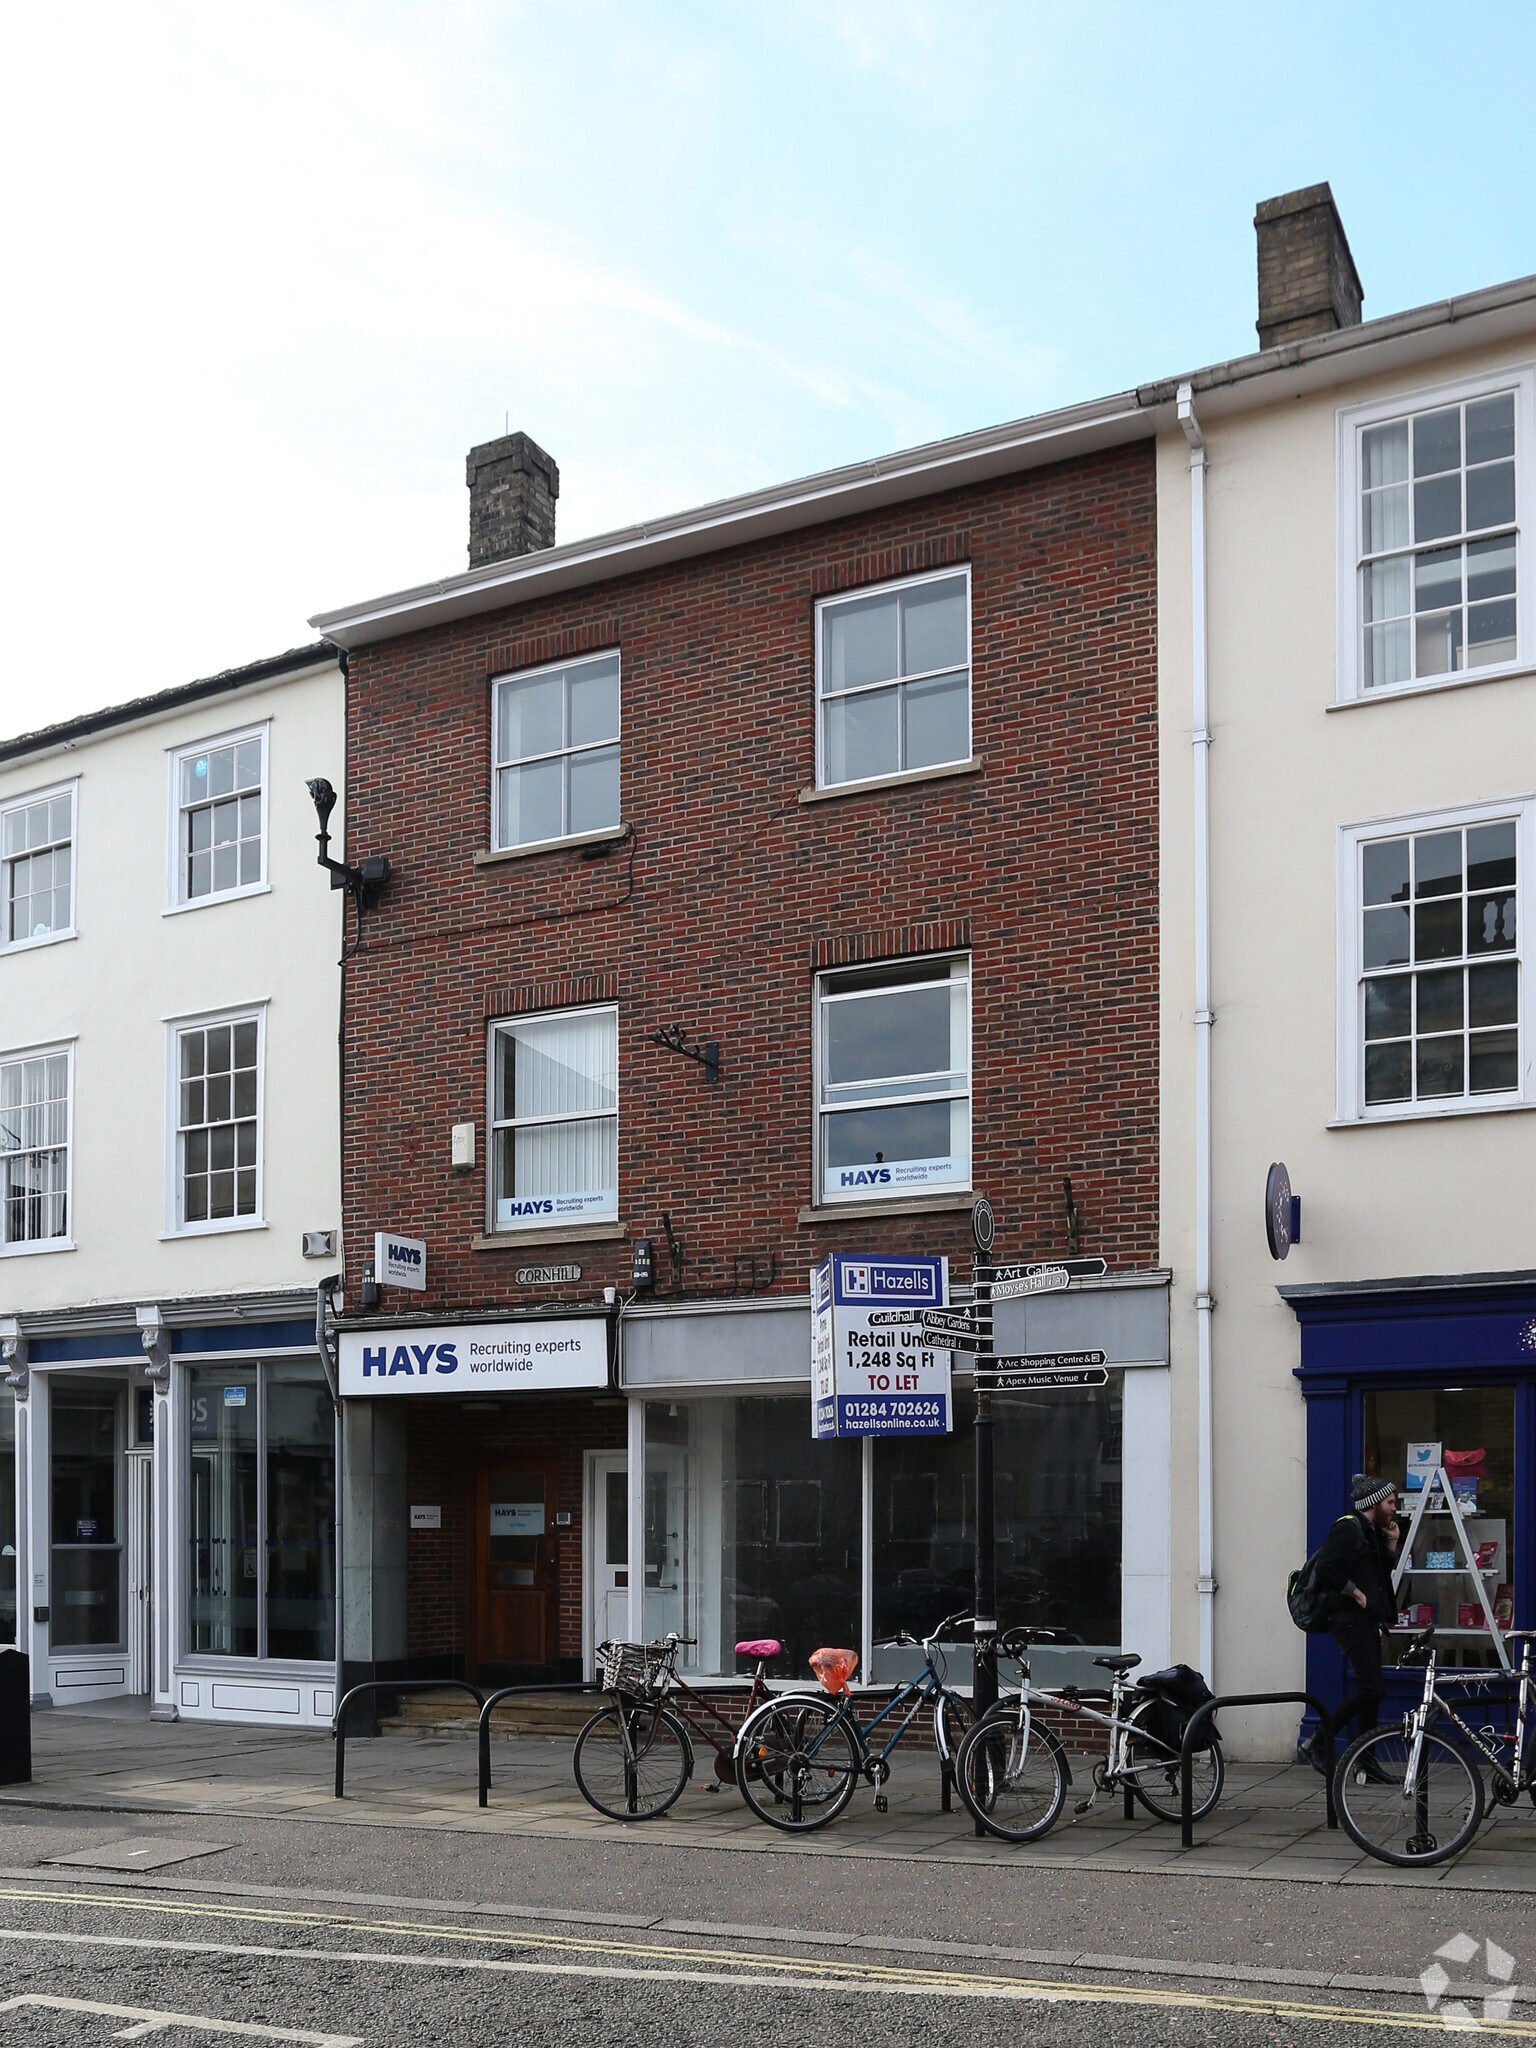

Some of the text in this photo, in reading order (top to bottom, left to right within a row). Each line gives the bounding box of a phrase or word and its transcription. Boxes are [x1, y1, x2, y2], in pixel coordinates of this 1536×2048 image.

[841, 1163, 952, 1186] HAYS Recruiting experts
[895, 1173, 928, 1181] worldwide
[511, 1195, 604, 1216] HAYS Recruiting experts
[556, 1204, 584, 1212] worldwide
[388, 1244, 421, 1265] HAYS
[388, 1261, 420, 1273] Recruiting experts
[388, 1269, 407, 1277] worldwide
[517, 1266, 578, 1283] CORNHILL
[1003, 1268, 1021, 1279] Art
[874, 1270, 929, 1290] Hazells
[995, 1281, 1029, 1296] Moyse's
[1030, 1275, 1046, 1290] Hall
[872, 1310, 914, 1323] Guildhall
[926, 1313, 970, 1331] Abbey Gardens
[848, 1331, 895, 1348] Retail
[926, 1332, 957, 1348] Cathedral
[362, 1338, 581, 1377] HAYS Recruiting experts
[847, 1351, 891, 1369] 1,248
[896, 1351, 916, 1371] Sq
[921, 1352, 935, 1368] Ft
[1005, 1360, 1019, 1368] Arc
[1020, 1356, 1056, 1367] Shopping
[1057, 1355, 1084, 1364] Centre
[470, 1358, 533, 1373] worldwide
[868, 1374, 919, 1391] TO LET
[1006, 1378, 1027, 1386] Apex
[1028, 1376, 1052, 1384] Music
[1053, 1374, 1079, 1383] Venue
[845, 1402, 887, 1417] 01284
[890, 1402, 940, 1416] 702626
[845, 1417, 940, 1430] hazellsonline.co.uk
[495, 1508, 517, 1516] HAYS
